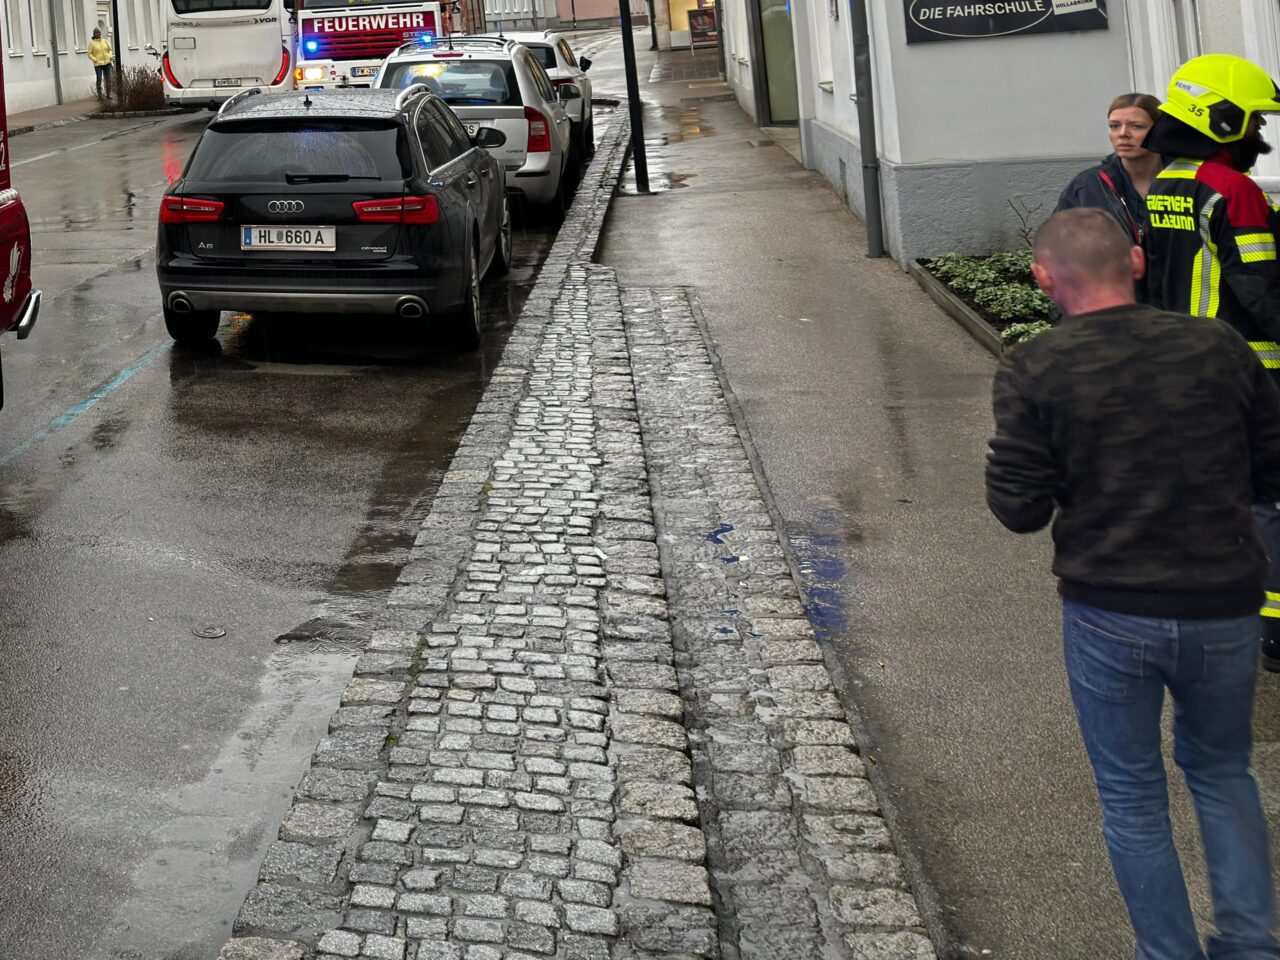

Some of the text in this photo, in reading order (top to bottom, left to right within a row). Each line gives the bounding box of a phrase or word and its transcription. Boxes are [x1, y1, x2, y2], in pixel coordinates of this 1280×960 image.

[920, 0, 1046, 20] DIE FAHRSCHULE
[313, 12, 424, 32] FEUERWEHR
[1188, 103, 1205, 117] 35
[258, 230, 274, 244] HL
[285, 229, 311, 244] 660
[315, 229, 324, 244] A
